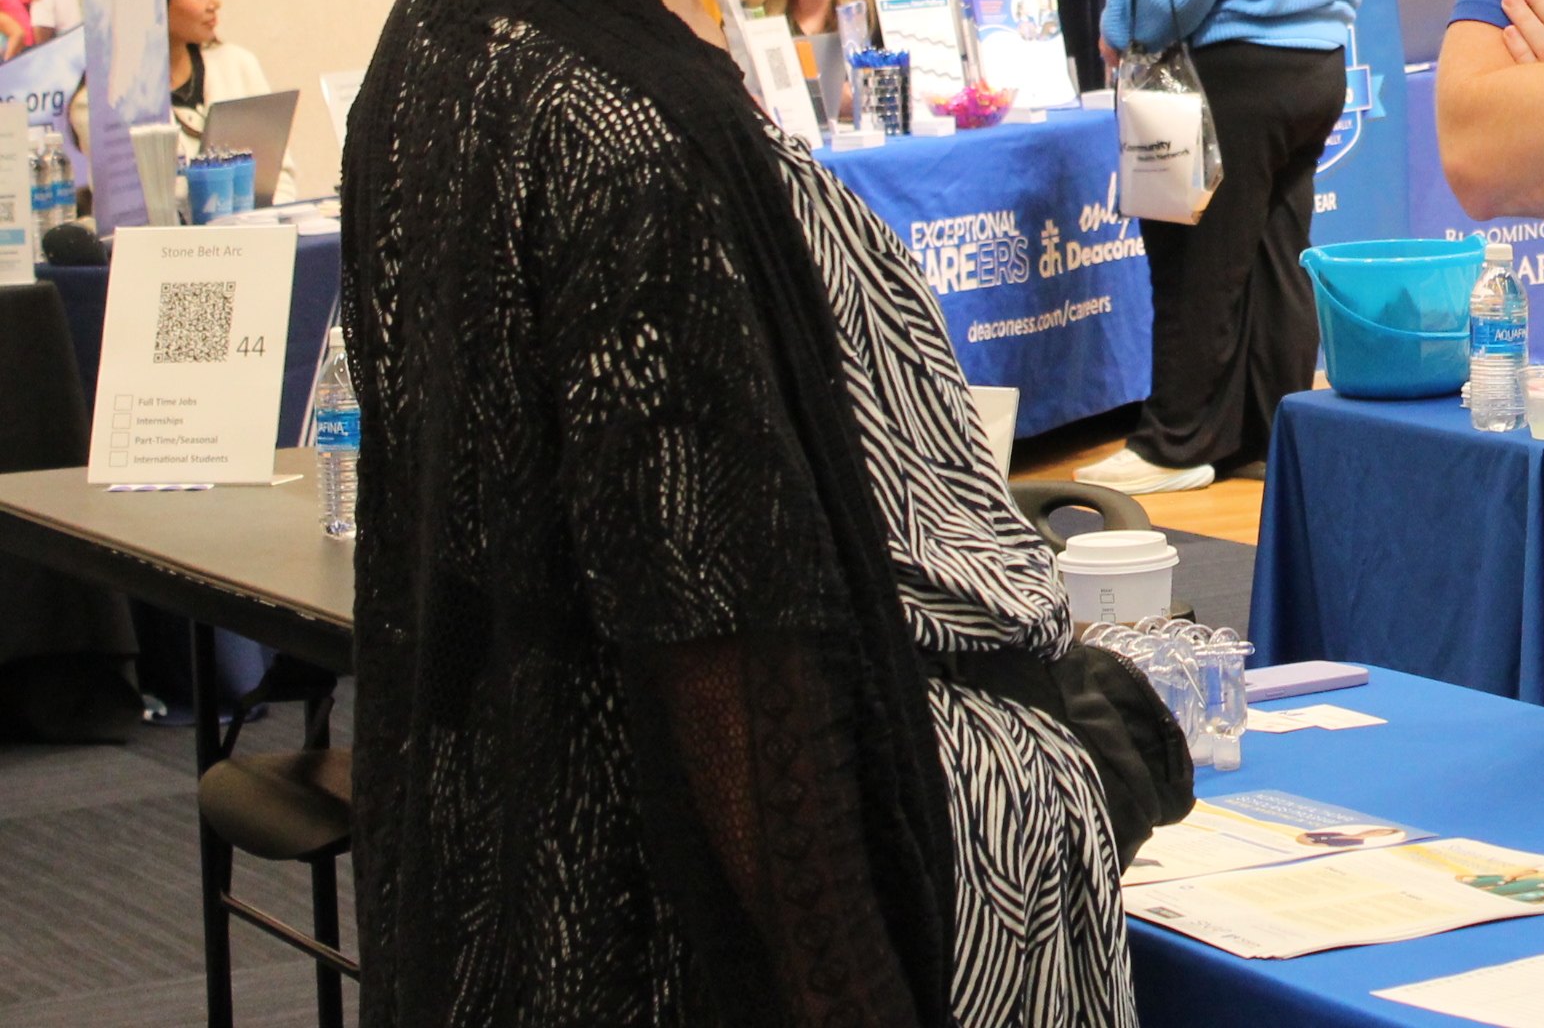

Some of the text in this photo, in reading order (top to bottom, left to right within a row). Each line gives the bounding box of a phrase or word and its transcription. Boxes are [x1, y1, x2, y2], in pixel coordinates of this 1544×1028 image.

[1313, 192, 1337, 213] EAR
[911, 210, 1020, 250] EXCEPTIONAL
[162, 245, 243, 258] Stone Belt Arc
[968, 295, 1112, 343] deaconess.com/careers
[236, 336, 266, 357] 44
[138, 397, 197, 407] Full Time Jobs
[136, 416, 183, 426] Internships
[135, 435, 218, 446] Part-Time/Seasonal
[134, 454, 229, 464] International Students
